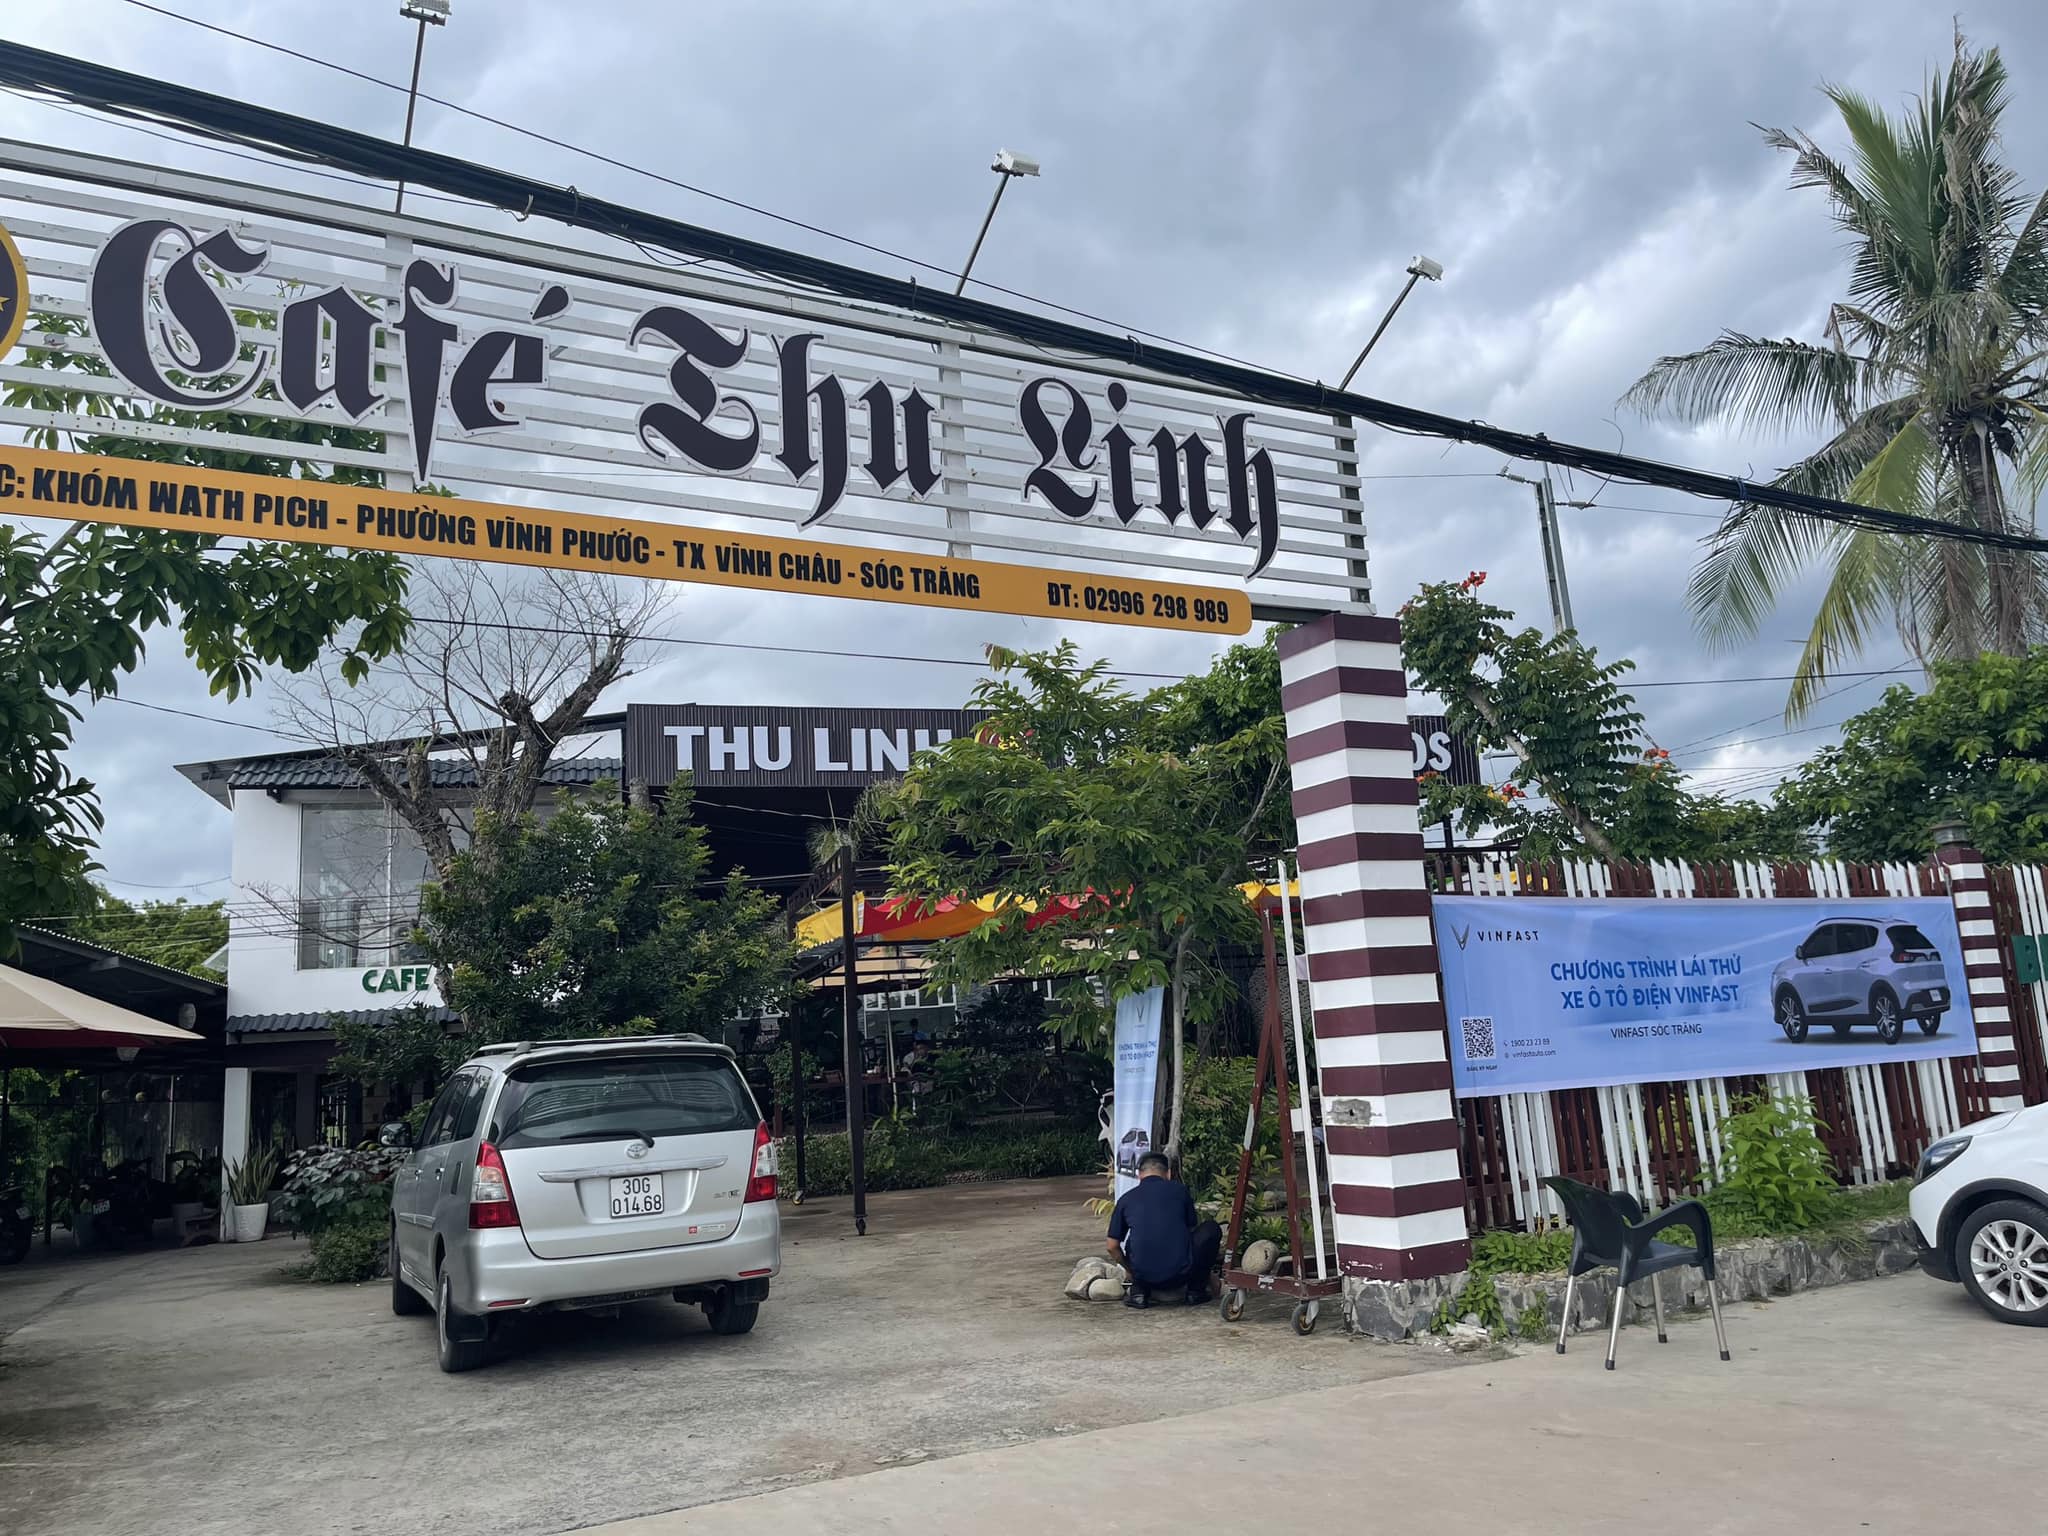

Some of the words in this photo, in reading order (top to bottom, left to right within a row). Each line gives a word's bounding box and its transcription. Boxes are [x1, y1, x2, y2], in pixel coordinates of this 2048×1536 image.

[88, 216, 572, 483] Café
[627, 305, 943, 527] Thu
[1018, 376, 1279, 580] Linh
[32, 468, 138, 510] KHÓM
[149, 480, 244, 521] WATH
[252, 493, 328, 530] PICH
[357, 504, 476, 545] PHƯỜNG
[486, 516, 552, 554] VĨNH
[562, 527, 650, 564] PHƯỚC
[673, 540, 706, 570] TX
[715, 542, 772, 577] VĨNH
[779, 552, 842, 585] CHÂU
[860, 559, 904, 591] SÓC
[910, 565, 981, 599] TRĂNG
[1047, 582, 1079, 608] ĐT:
[1083, 586, 1145, 615] 02996
[1152, 593, 1188, 620] 298
[1193, 598, 1229, 624] 989
[663, 725, 792, 772] THU
[1477, 930, 1539, 942] VINFAST
[361, 967, 430, 994] CAFE
[1550, 960, 1625, 982] CHƯƠNG
[1627, 956, 1678, 979] TRÌNH
[1680, 954, 1707, 977] LÁI
[1709, 953, 1742, 976] THỬ
[1560, 990, 1585, 1009] XE
[1588, 985, 1601, 1008] Ô
[1604, 984, 1628, 1008] TÔ
[1632, 983, 1671, 1010] ĐIỆN
[1673, 984, 1740, 1005] VINFAST
[1610, 1026, 1649, 1039] VINFAST
[1650, 1024, 1670, 1037] SÓC
[622, 1177, 651, 1196] 30G
[612, 1194, 663, 1215] 014.68
